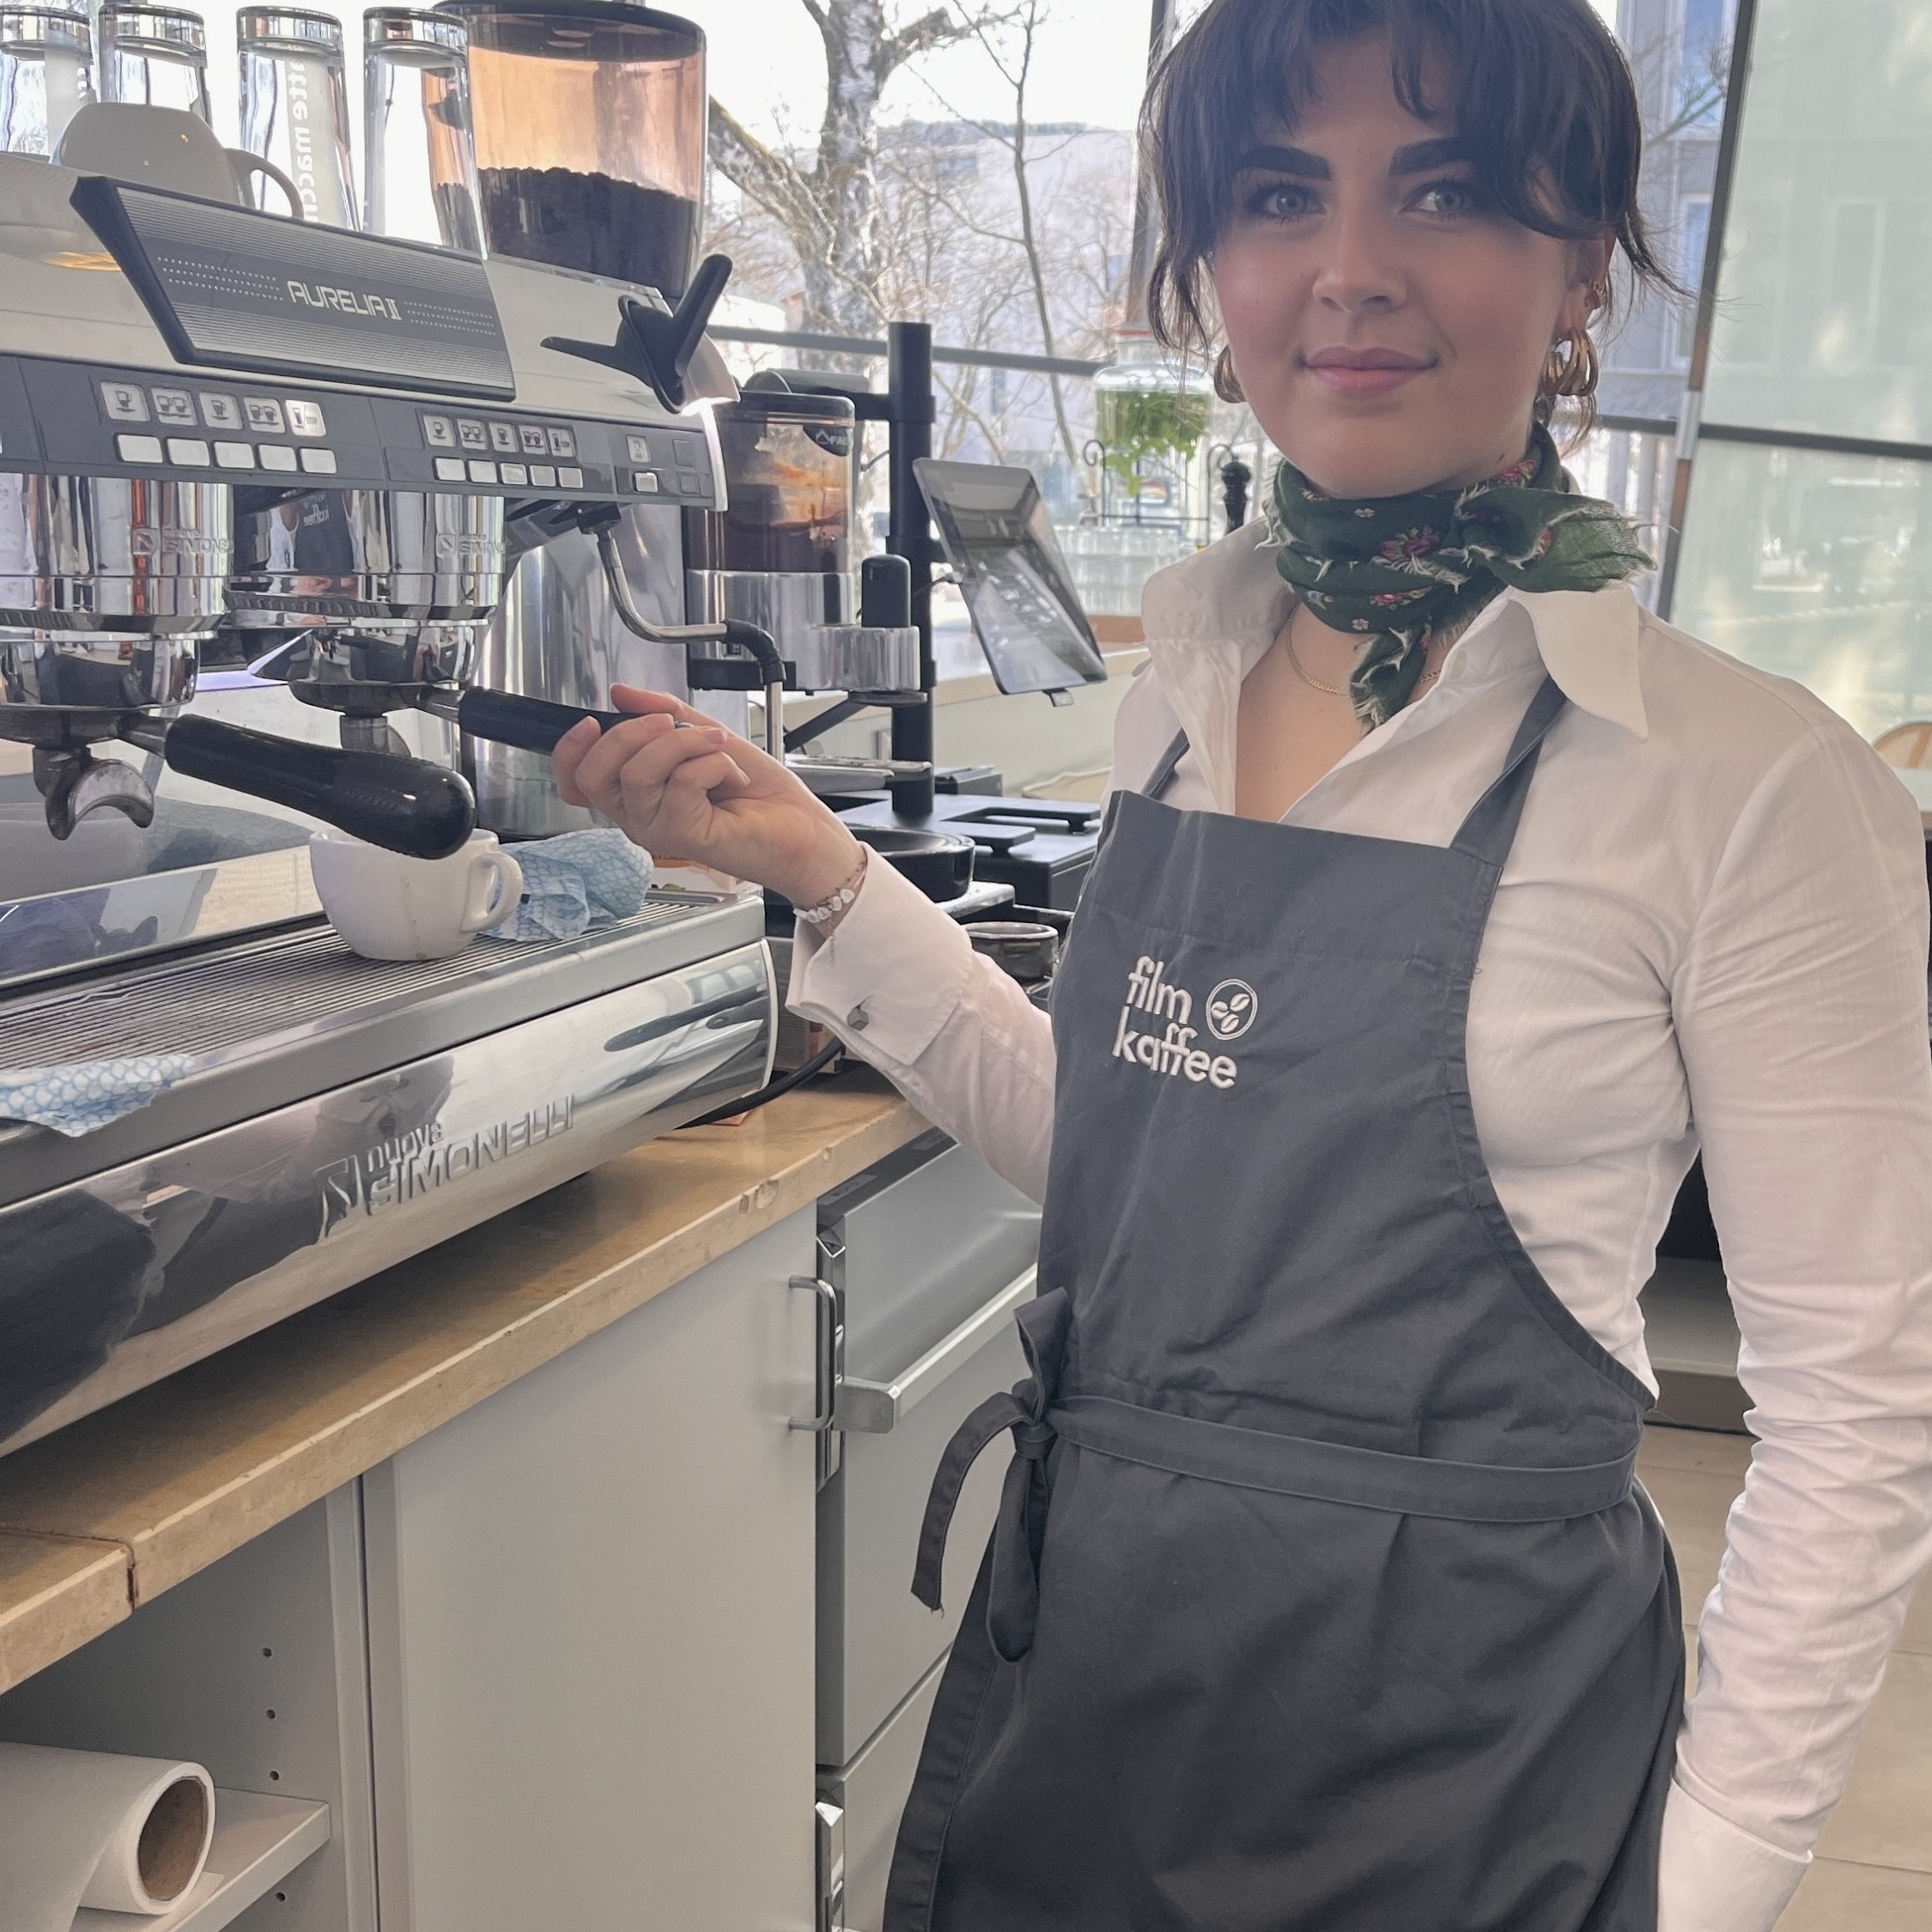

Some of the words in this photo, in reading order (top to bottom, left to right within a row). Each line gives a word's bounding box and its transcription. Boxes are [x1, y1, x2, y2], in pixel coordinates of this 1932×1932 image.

[287, 280, 388, 319] AURELIA
[385, 297, 402, 320] II
[1127, 956, 1193, 1024] film
[1111, 1005, 1237, 1090] kaffee
[367, 1121, 445, 1173] nuova
[369, 1094, 574, 1206] SIMONELLI
